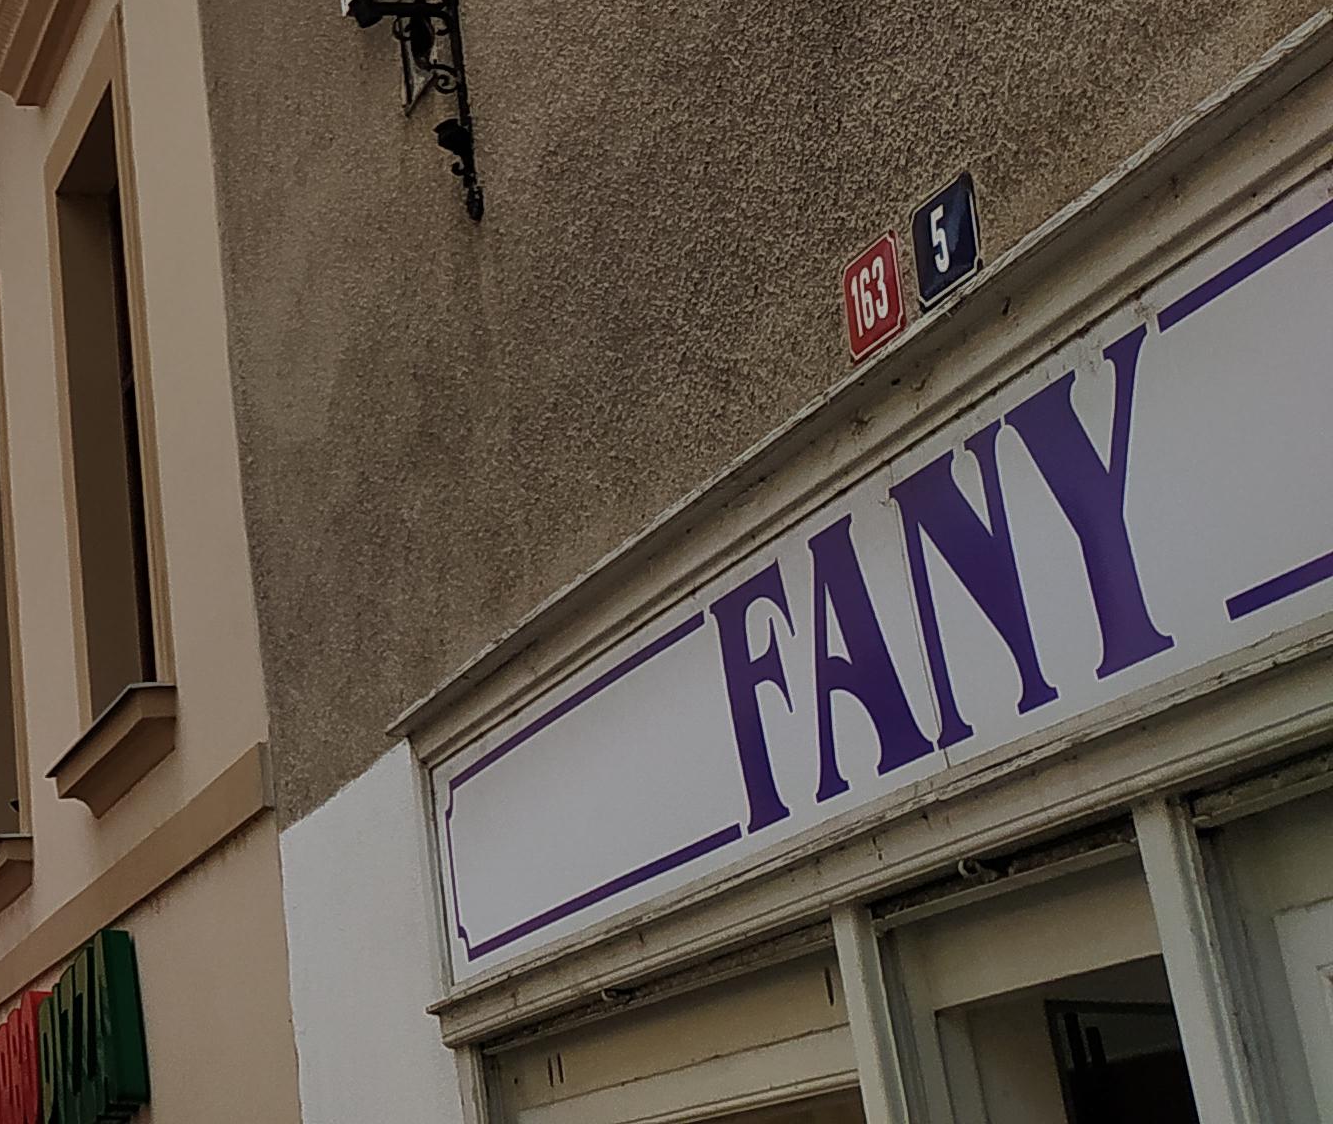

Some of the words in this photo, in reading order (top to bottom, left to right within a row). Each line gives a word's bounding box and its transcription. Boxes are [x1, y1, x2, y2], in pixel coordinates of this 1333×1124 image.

[930, 204, 950, 273] 5
[850, 256, 889, 337] 163
[706, 324, 1175, 834] FANY
